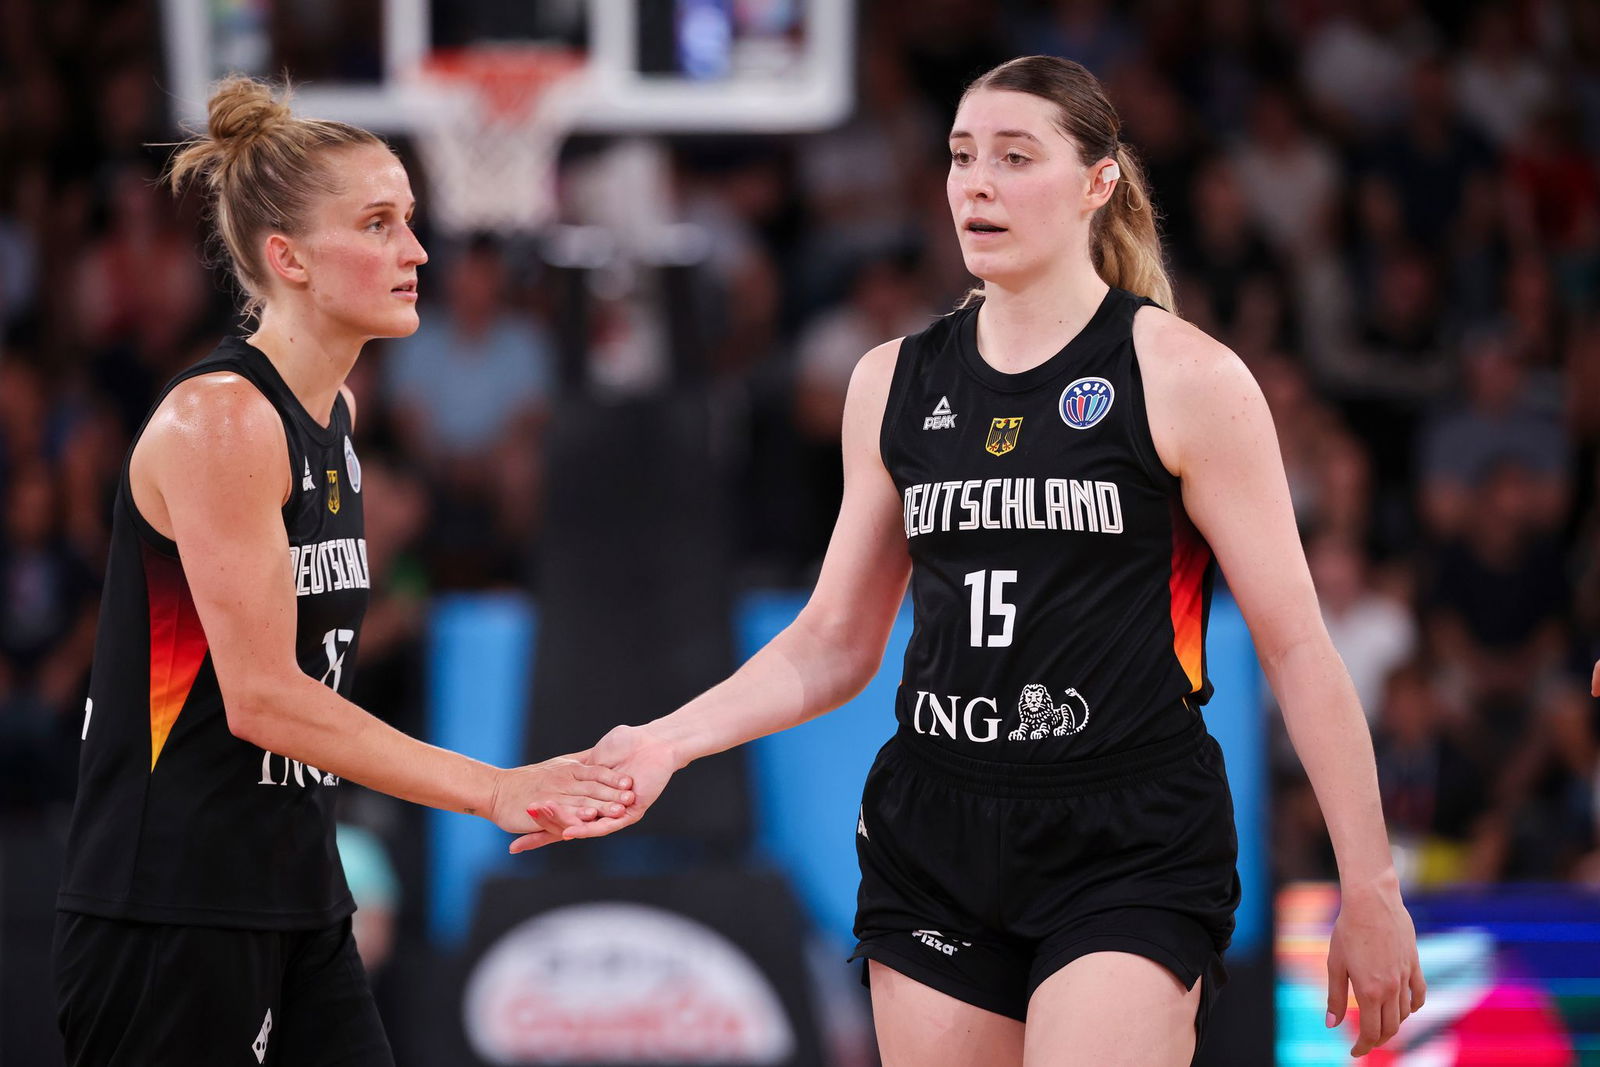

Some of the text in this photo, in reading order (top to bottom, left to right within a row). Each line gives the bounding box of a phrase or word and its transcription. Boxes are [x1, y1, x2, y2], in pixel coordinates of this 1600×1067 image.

[922, 413, 958, 431] PEAK
[903, 477, 1124, 539] DEUTSCHLAND
[963, 569, 1018, 648] 15
[913, 690, 1003, 743] ING
[257, 750, 322, 788] IN
